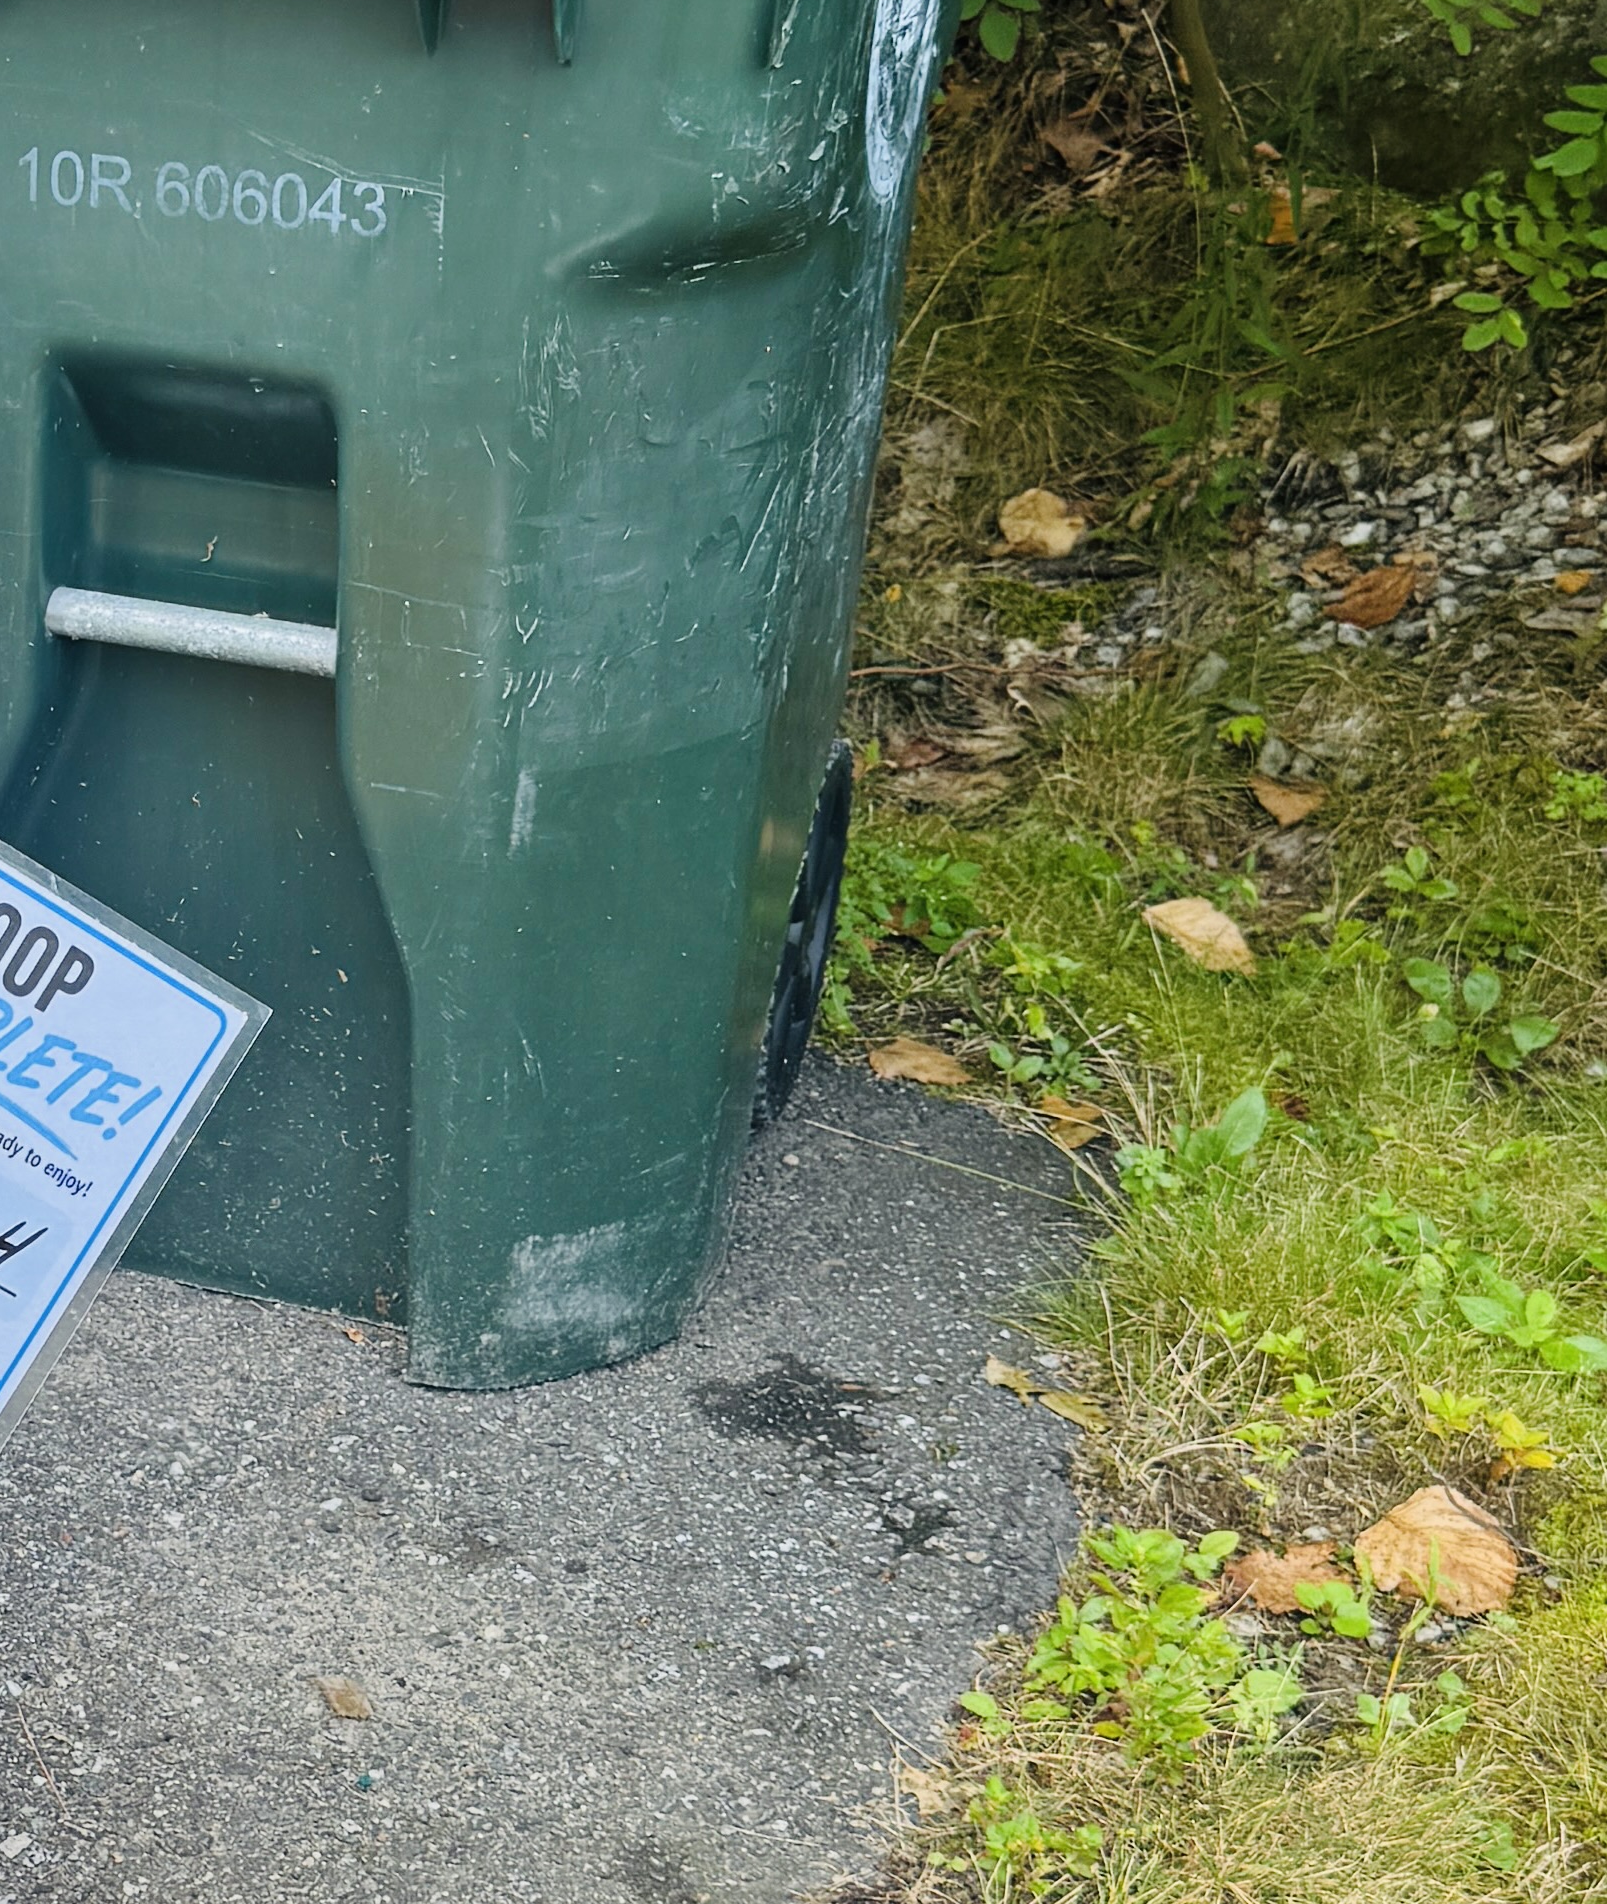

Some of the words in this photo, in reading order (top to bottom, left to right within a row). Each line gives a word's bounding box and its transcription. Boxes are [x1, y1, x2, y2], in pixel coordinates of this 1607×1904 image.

[18, 146, 133, 214] 10R
[156, 161, 388, 237] 606043
[24, 1148, 41, 1169] to
[43, 1160, 94, 1198] enjoy!
